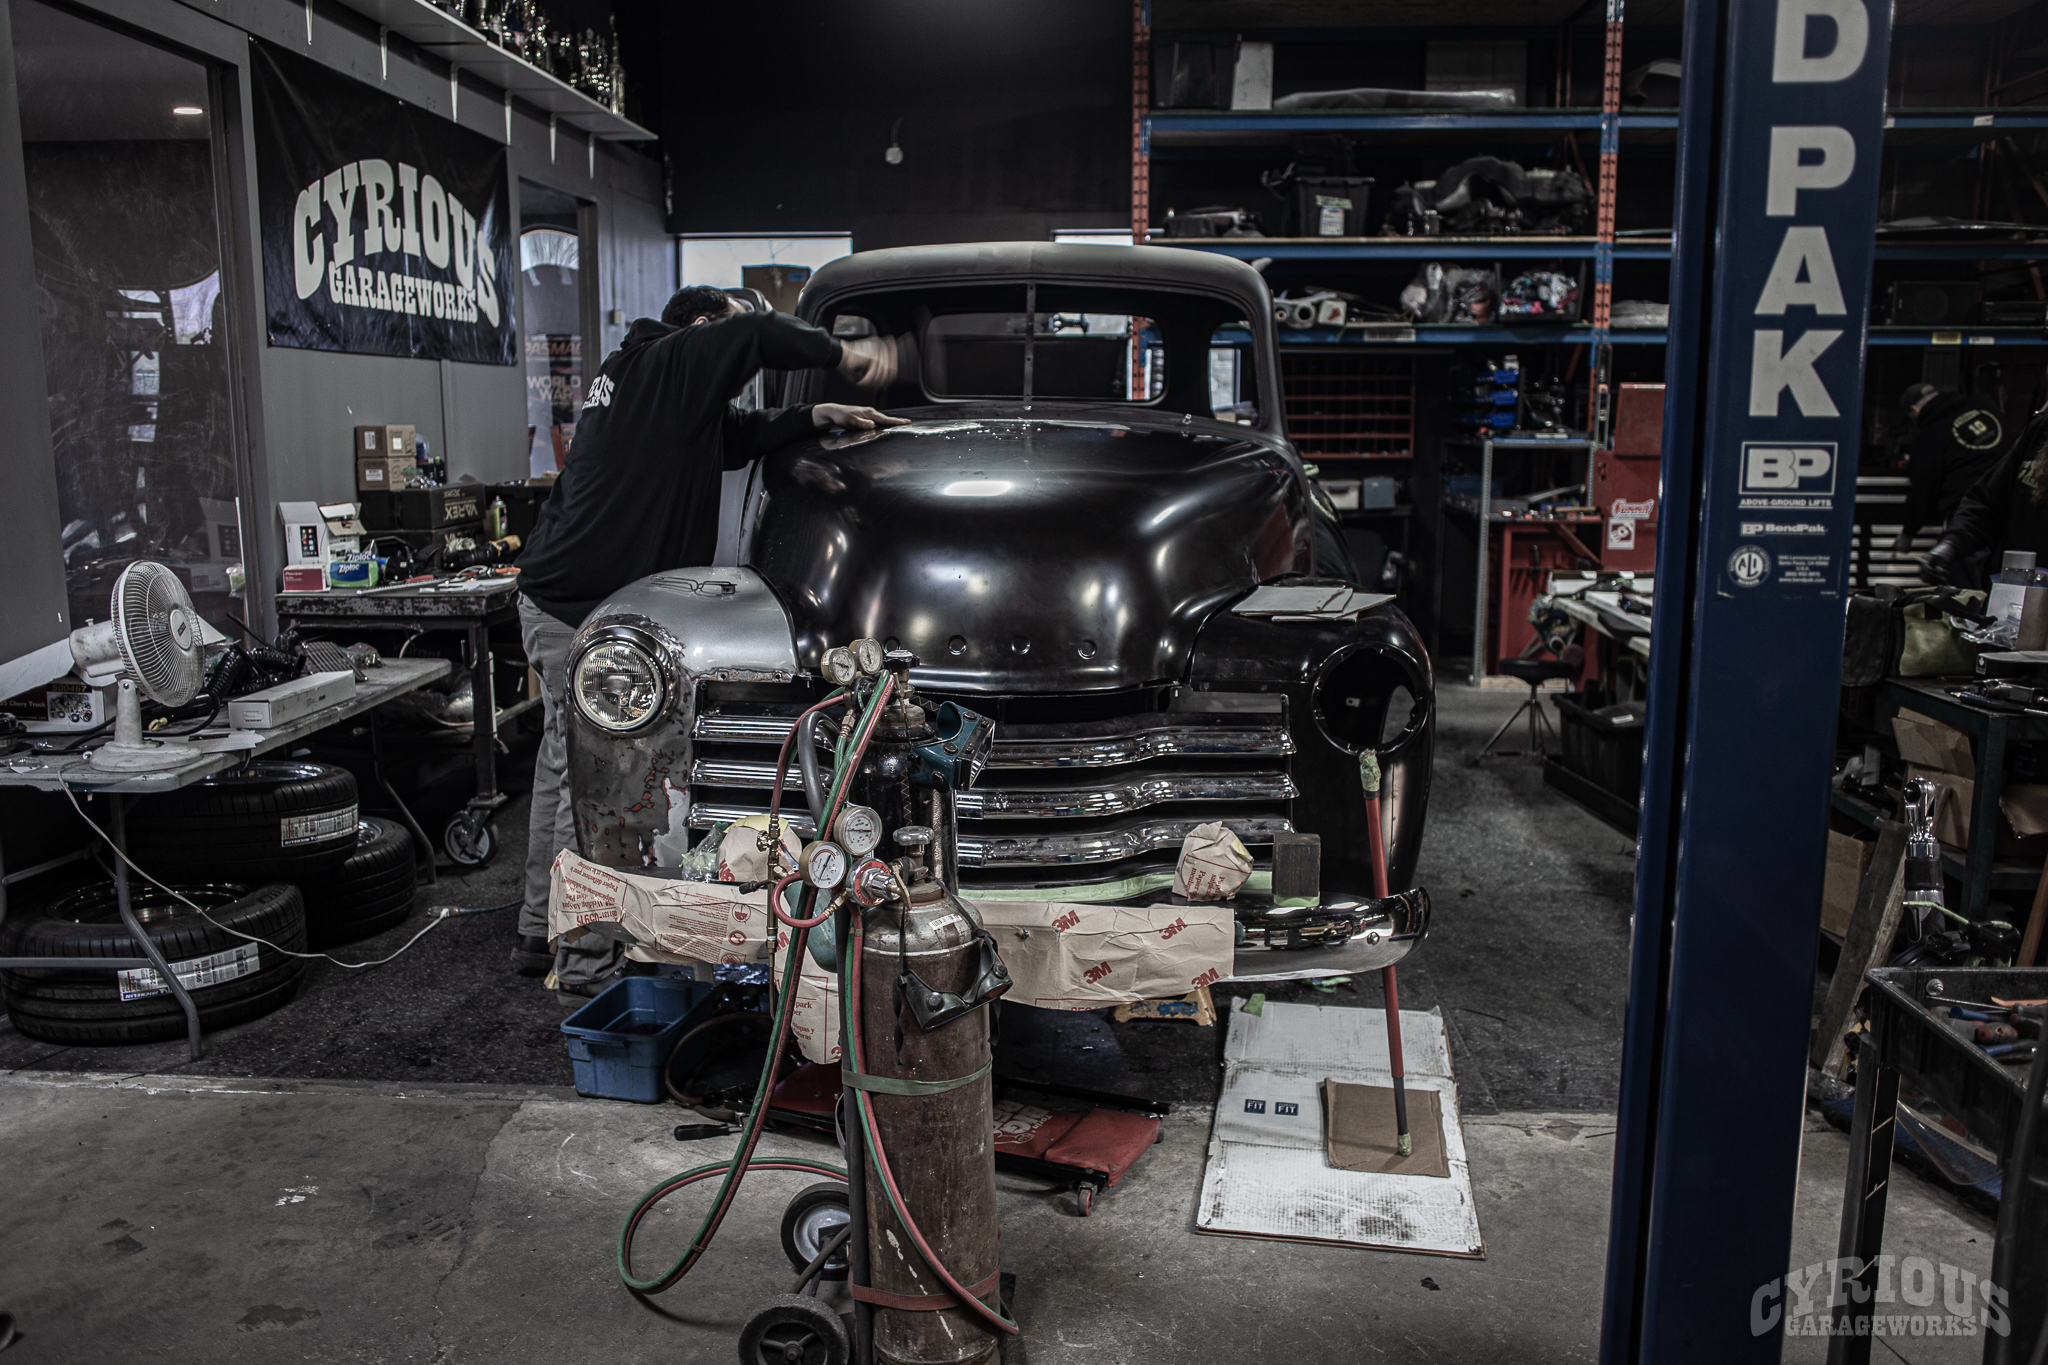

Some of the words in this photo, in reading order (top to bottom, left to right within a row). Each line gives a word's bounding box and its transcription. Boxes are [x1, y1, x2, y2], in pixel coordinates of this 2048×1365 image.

[294, 159, 500, 328] CYRIOUS
[328, 261, 478, 323] GARAGEWORKS
[526, 375, 581, 389] WORLD
[539, 386, 573, 402] WAR
[1746, 449, 1831, 488] BP
[1741, 498, 1807, 506] ABOVE-GROUND
[1808, 499, 1832, 507] LIFTS
[445, 502, 478, 520] VAREX
[1742, 523, 1764, 535] BP
[1765, 523, 1827, 532] BendPak
[347, 553, 371, 562] Ziploc
[339, 563, 360, 574] Ziploc
[9, 700, 27, 708] Chevy
[602, 881, 618, 892] Papier
[1194, 870, 1206, 891] Papier
[581, 900, 603, 908] Welding
[1052, 910, 1081, 933] 3M
[1159, 918, 1188, 940] 3M
[1083, 961, 1112, 984] 3M
[1191, 967, 1220, 991] 3M
[125, 990, 158, 999] MICHELIN
[795, 1001, 812, 1009] park
[1247, 1102, 1264, 1110] FIT
[1000, 1105, 1050, 1134] BIG
[1032, 1115, 1053, 1130] Torin
